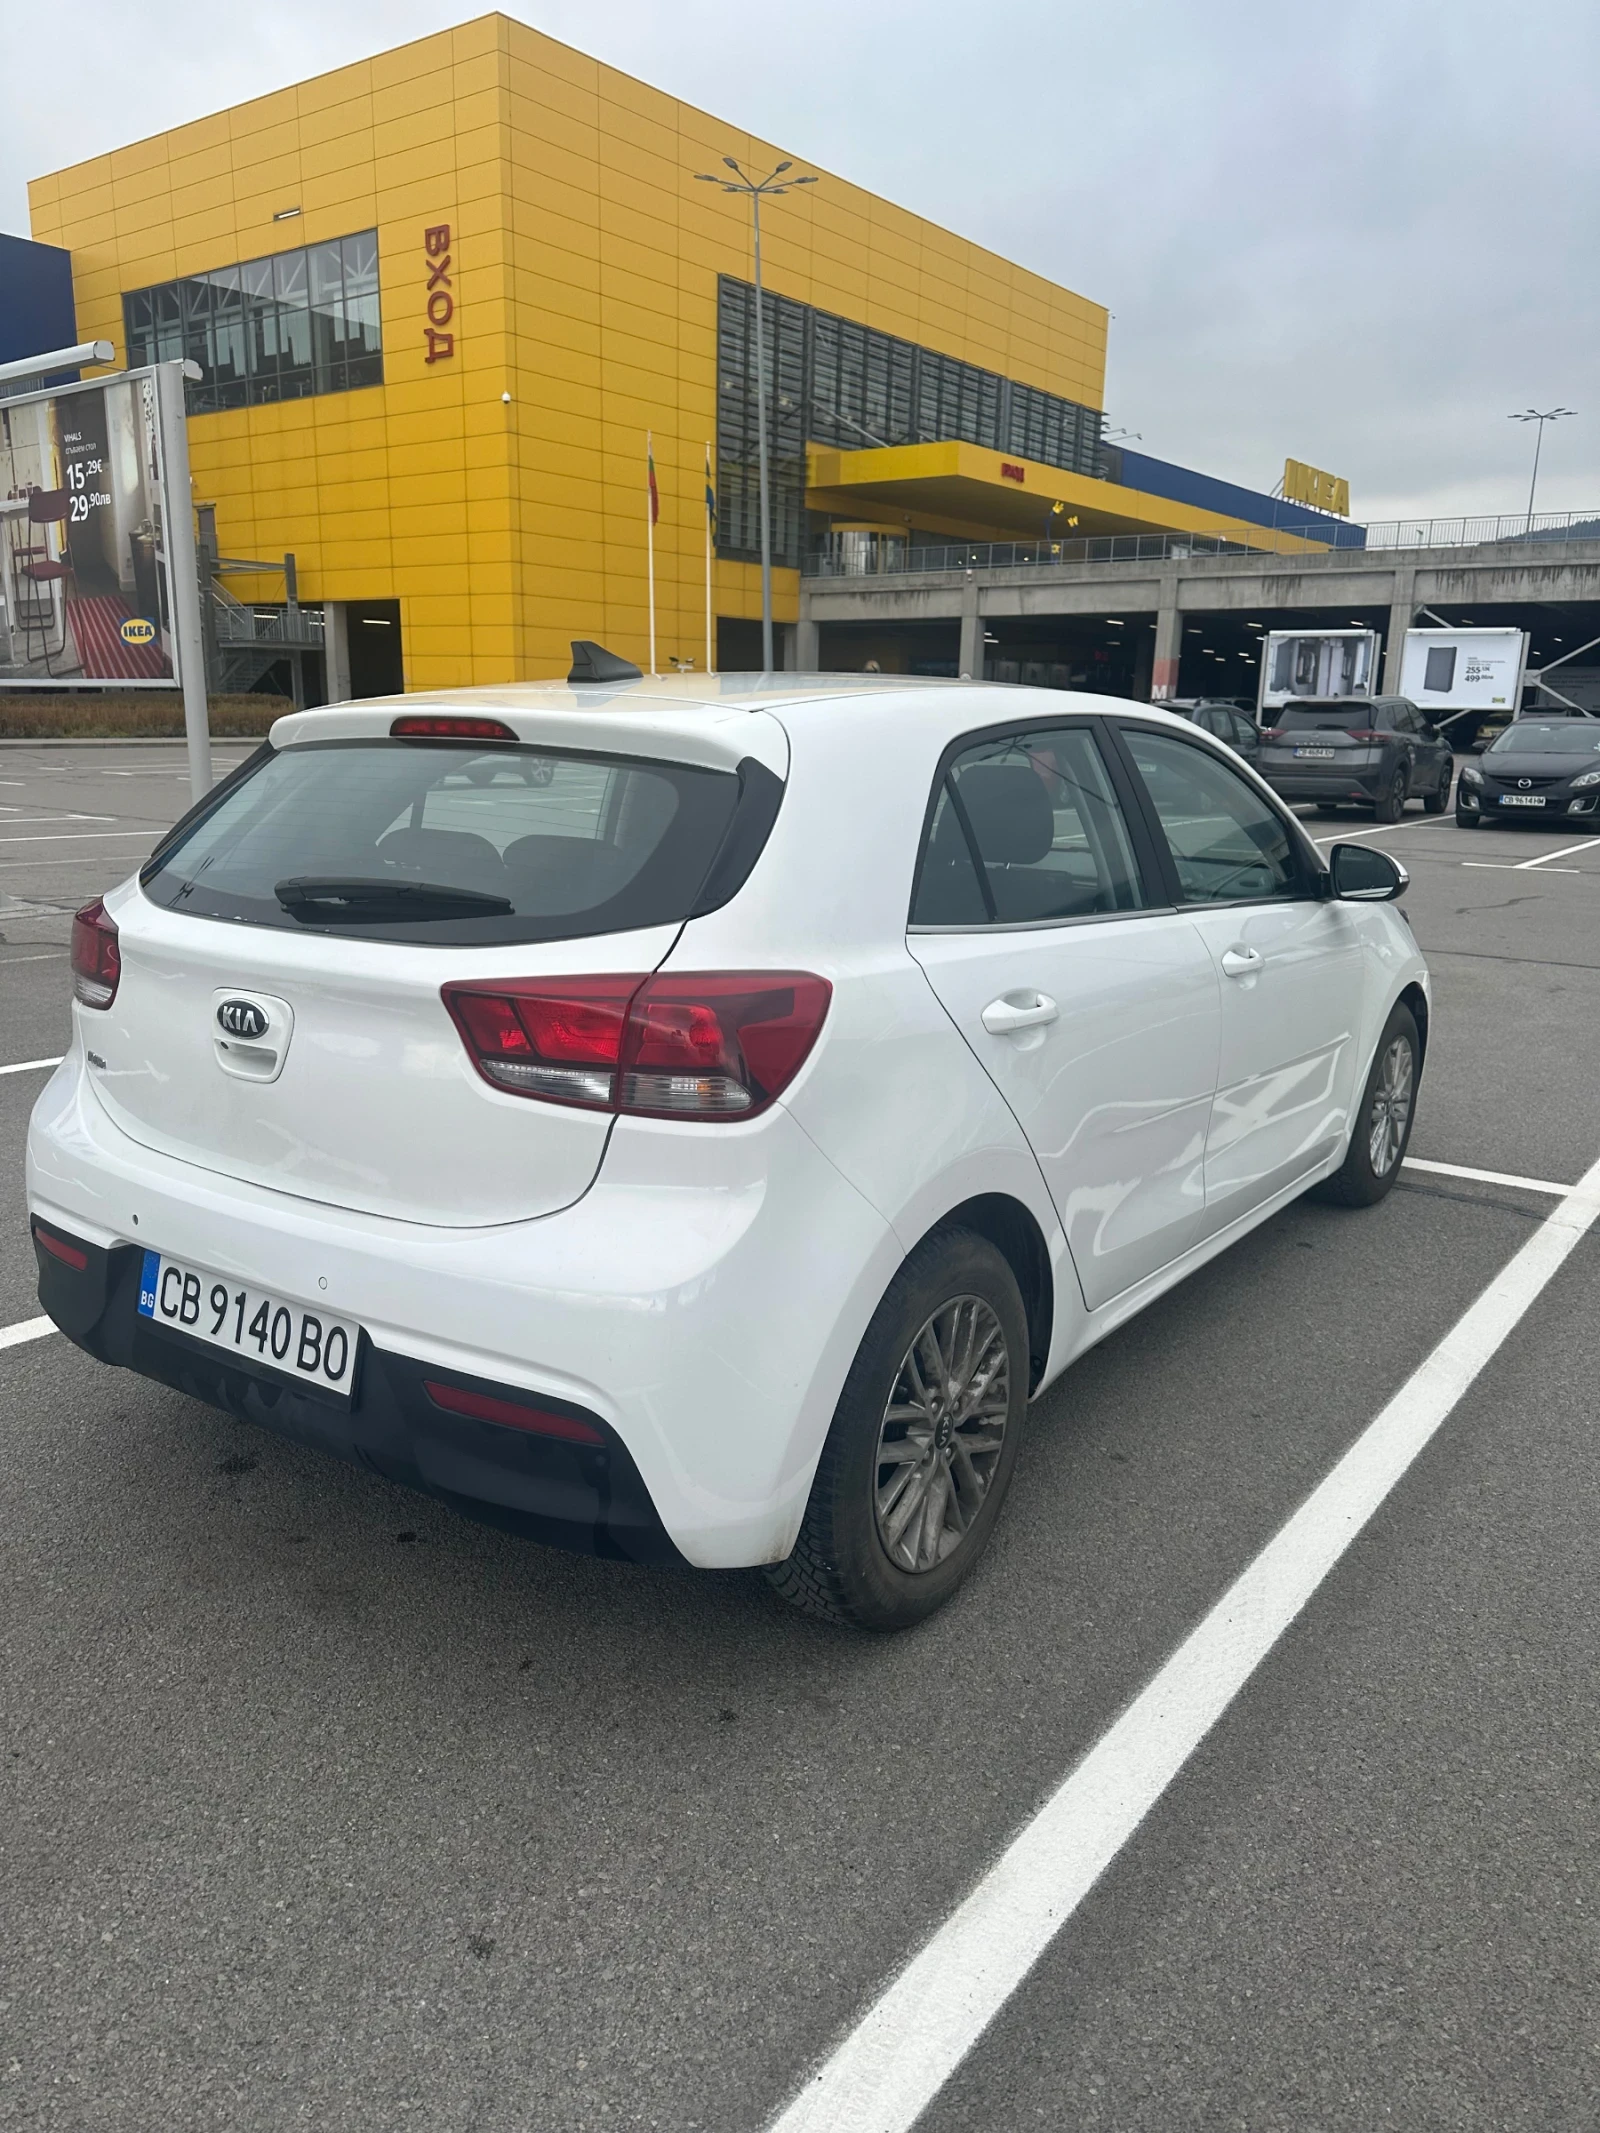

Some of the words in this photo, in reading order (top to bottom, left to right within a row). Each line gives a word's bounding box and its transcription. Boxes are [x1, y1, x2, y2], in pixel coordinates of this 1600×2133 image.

[424, 224, 454, 364] ВХОД
[1283, 457, 1350, 517] IKEA
[123, 625, 153, 637] IKEA
[222, 1005, 258, 1032] KIA
[141, 1290, 155, 1309] BG
[160, 1266, 201, 1325] CB
[210, 1284, 292, 1360] 9140
